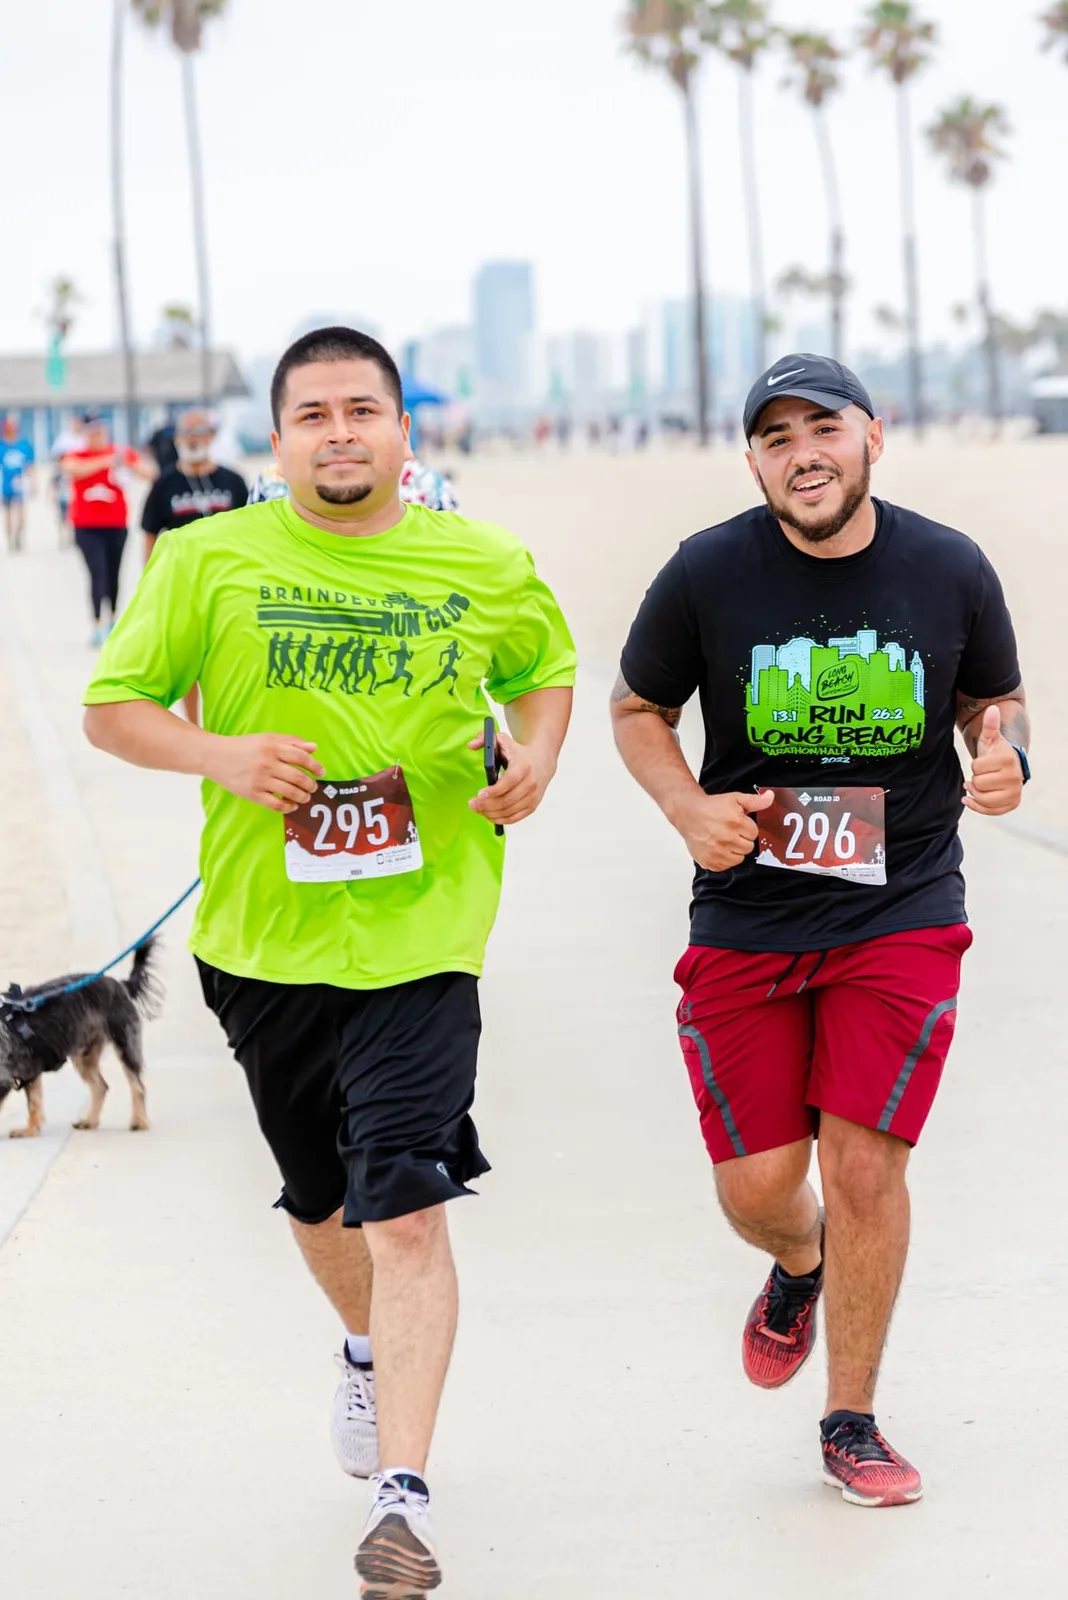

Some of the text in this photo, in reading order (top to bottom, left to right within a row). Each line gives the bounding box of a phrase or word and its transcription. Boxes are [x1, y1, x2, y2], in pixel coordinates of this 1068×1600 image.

[382, 611, 421, 637] RUN
[821, 671, 855, 692] BEACH
[828, 665, 847, 679] LONG
[773, 703, 904, 724] 13.1 RUN 26.2
[751, 722, 922, 745] LONG BEACH
[821, 756, 851, 765] 2022
[851, 746, 909, 756] MARATHON
[339, 786, 359, 796] ROAD
[310, 797, 390, 851] 295
[783, 812, 856, 859] 296
